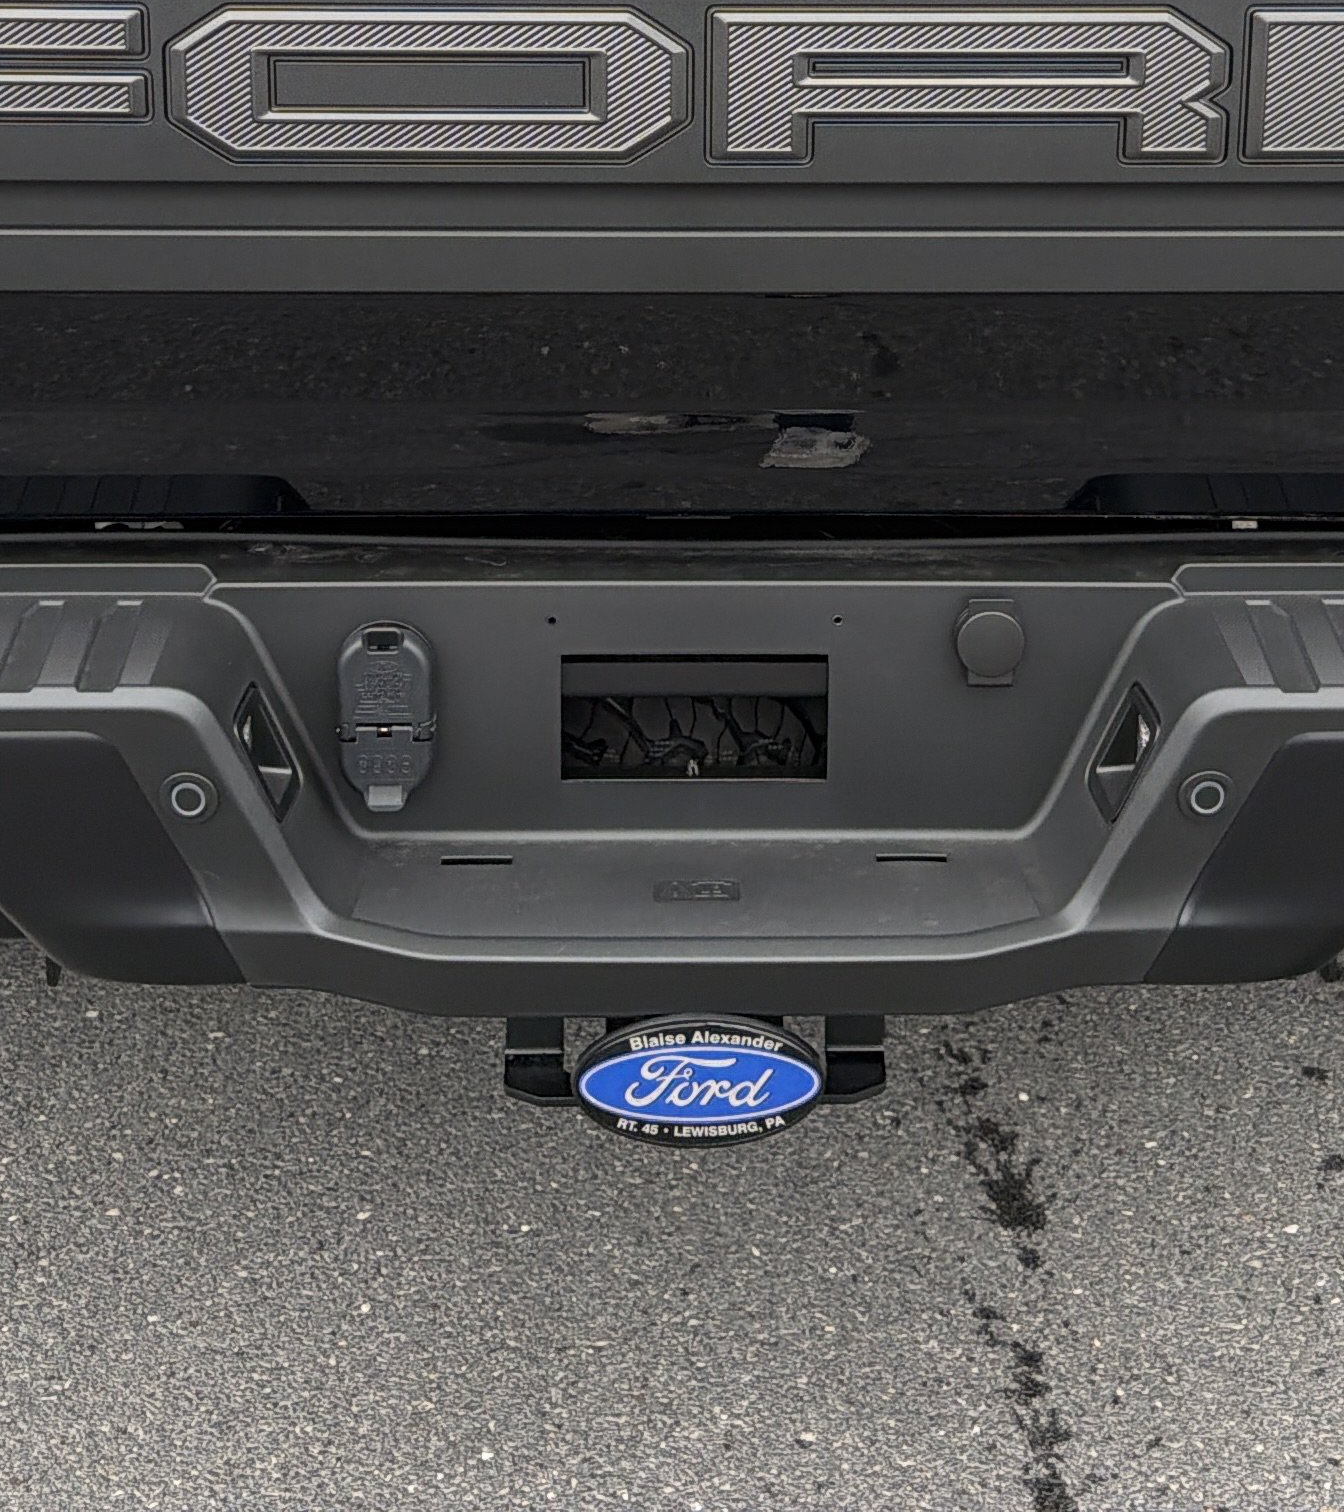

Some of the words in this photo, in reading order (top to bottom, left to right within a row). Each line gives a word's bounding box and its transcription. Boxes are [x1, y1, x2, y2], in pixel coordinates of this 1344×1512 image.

[628, 1033, 687, 1052] Blaise
[690, 1030, 784, 1052] Alexander
[624, 1054, 774, 1108] Ford
[616, 1117, 639, 1134] RT.
[641, 1123, 659, 1136] 45
[672, 1121, 764, 1138] LEWISBURG,
[765, 1115, 786, 1132] PA
